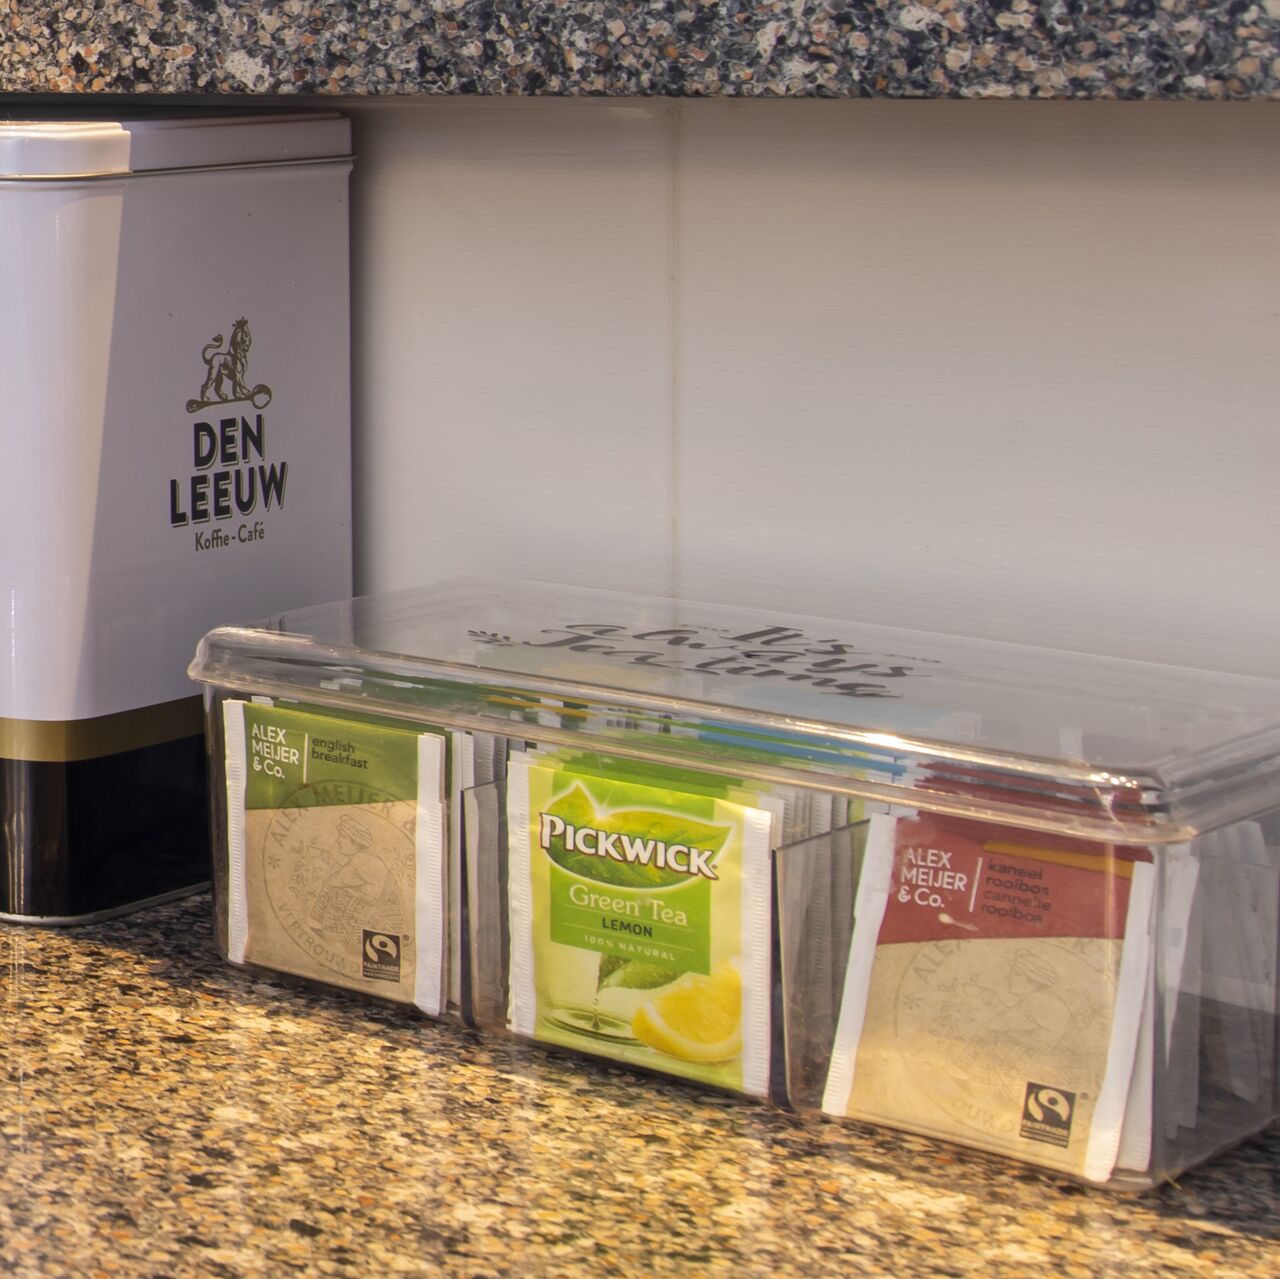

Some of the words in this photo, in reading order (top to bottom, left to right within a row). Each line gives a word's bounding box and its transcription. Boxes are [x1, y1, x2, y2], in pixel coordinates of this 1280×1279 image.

[193, 413, 265, 471] DEN
[170, 461, 288, 528] LEEUW
[251, 723, 287, 745] ALEX
[312, 736, 355, 754] english
[252, 741, 300, 766] MEIJER
[311, 749, 369, 770] breakfast
[263, 761, 286, 779] Co.
[539, 812, 719, 881] PICKWICK
[904, 847, 953, 869] ALEX
[988, 858, 1044, 880] kaneel
[900, 867, 968, 892] MEIJER
[569, 883, 640, 916] Green
[651, 899, 689, 927] Tea
[913, 887, 946, 908] Co.
[601, 916, 654, 938] LEMON
[583, 933, 614, 949] 100%
[618, 942, 676, 962] NATURAL
